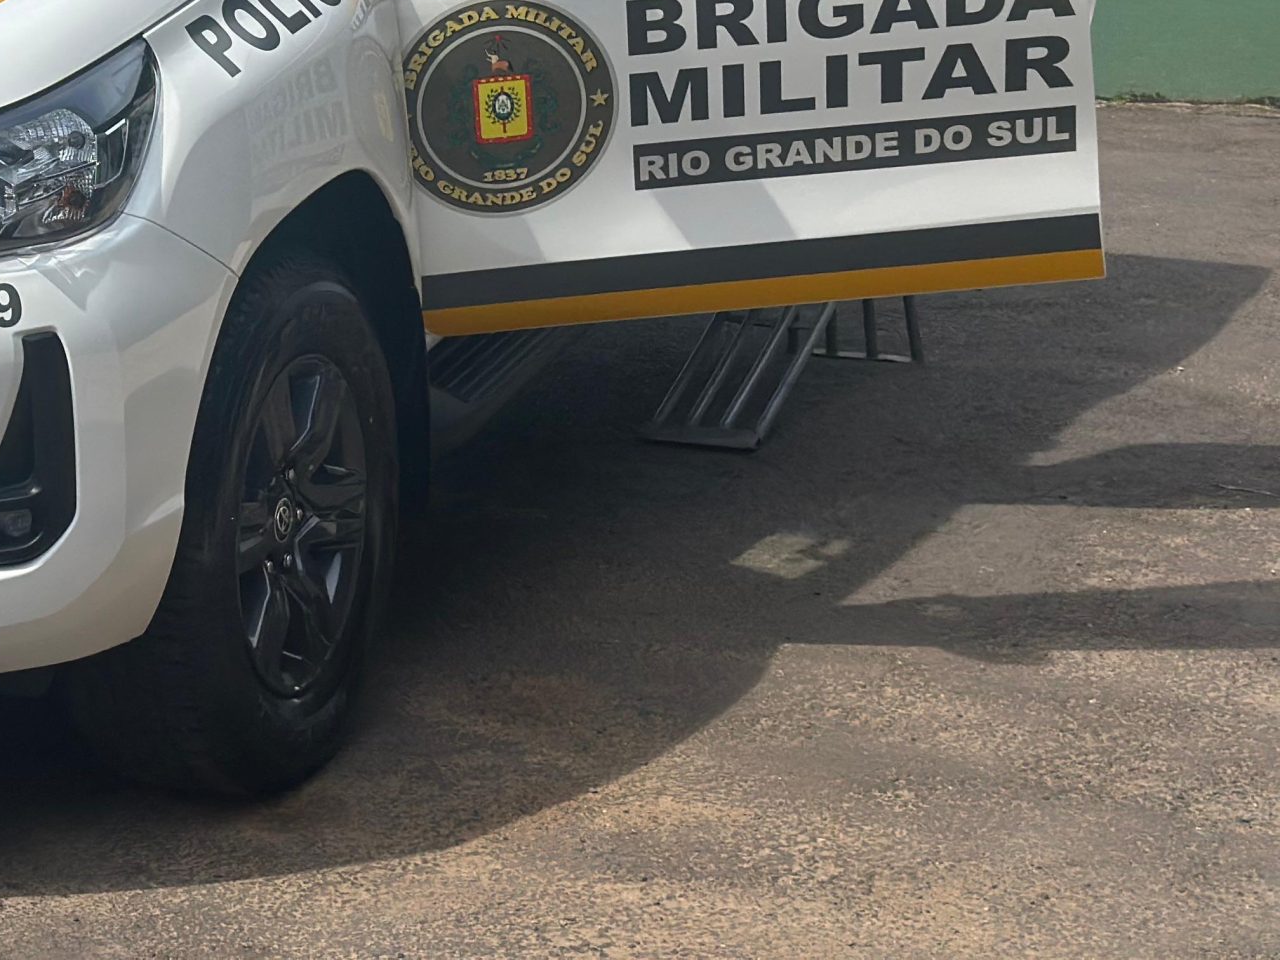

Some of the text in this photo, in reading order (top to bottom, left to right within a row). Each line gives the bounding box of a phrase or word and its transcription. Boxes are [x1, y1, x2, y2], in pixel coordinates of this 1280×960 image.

[404, 6, 500, 90] BRIGADA
[505, 4, 599, 73] MILITAR
[629, 35, 1074, 127] MILITAR
[439, 180, 537, 206] GRANDE
[538, 166, 572, 189] DO
[572, 119, 604, 168] SUL
[483, 167, 529, 182] 1837
[639, 115, 1070, 181] RIO GRANDE DO SUL
